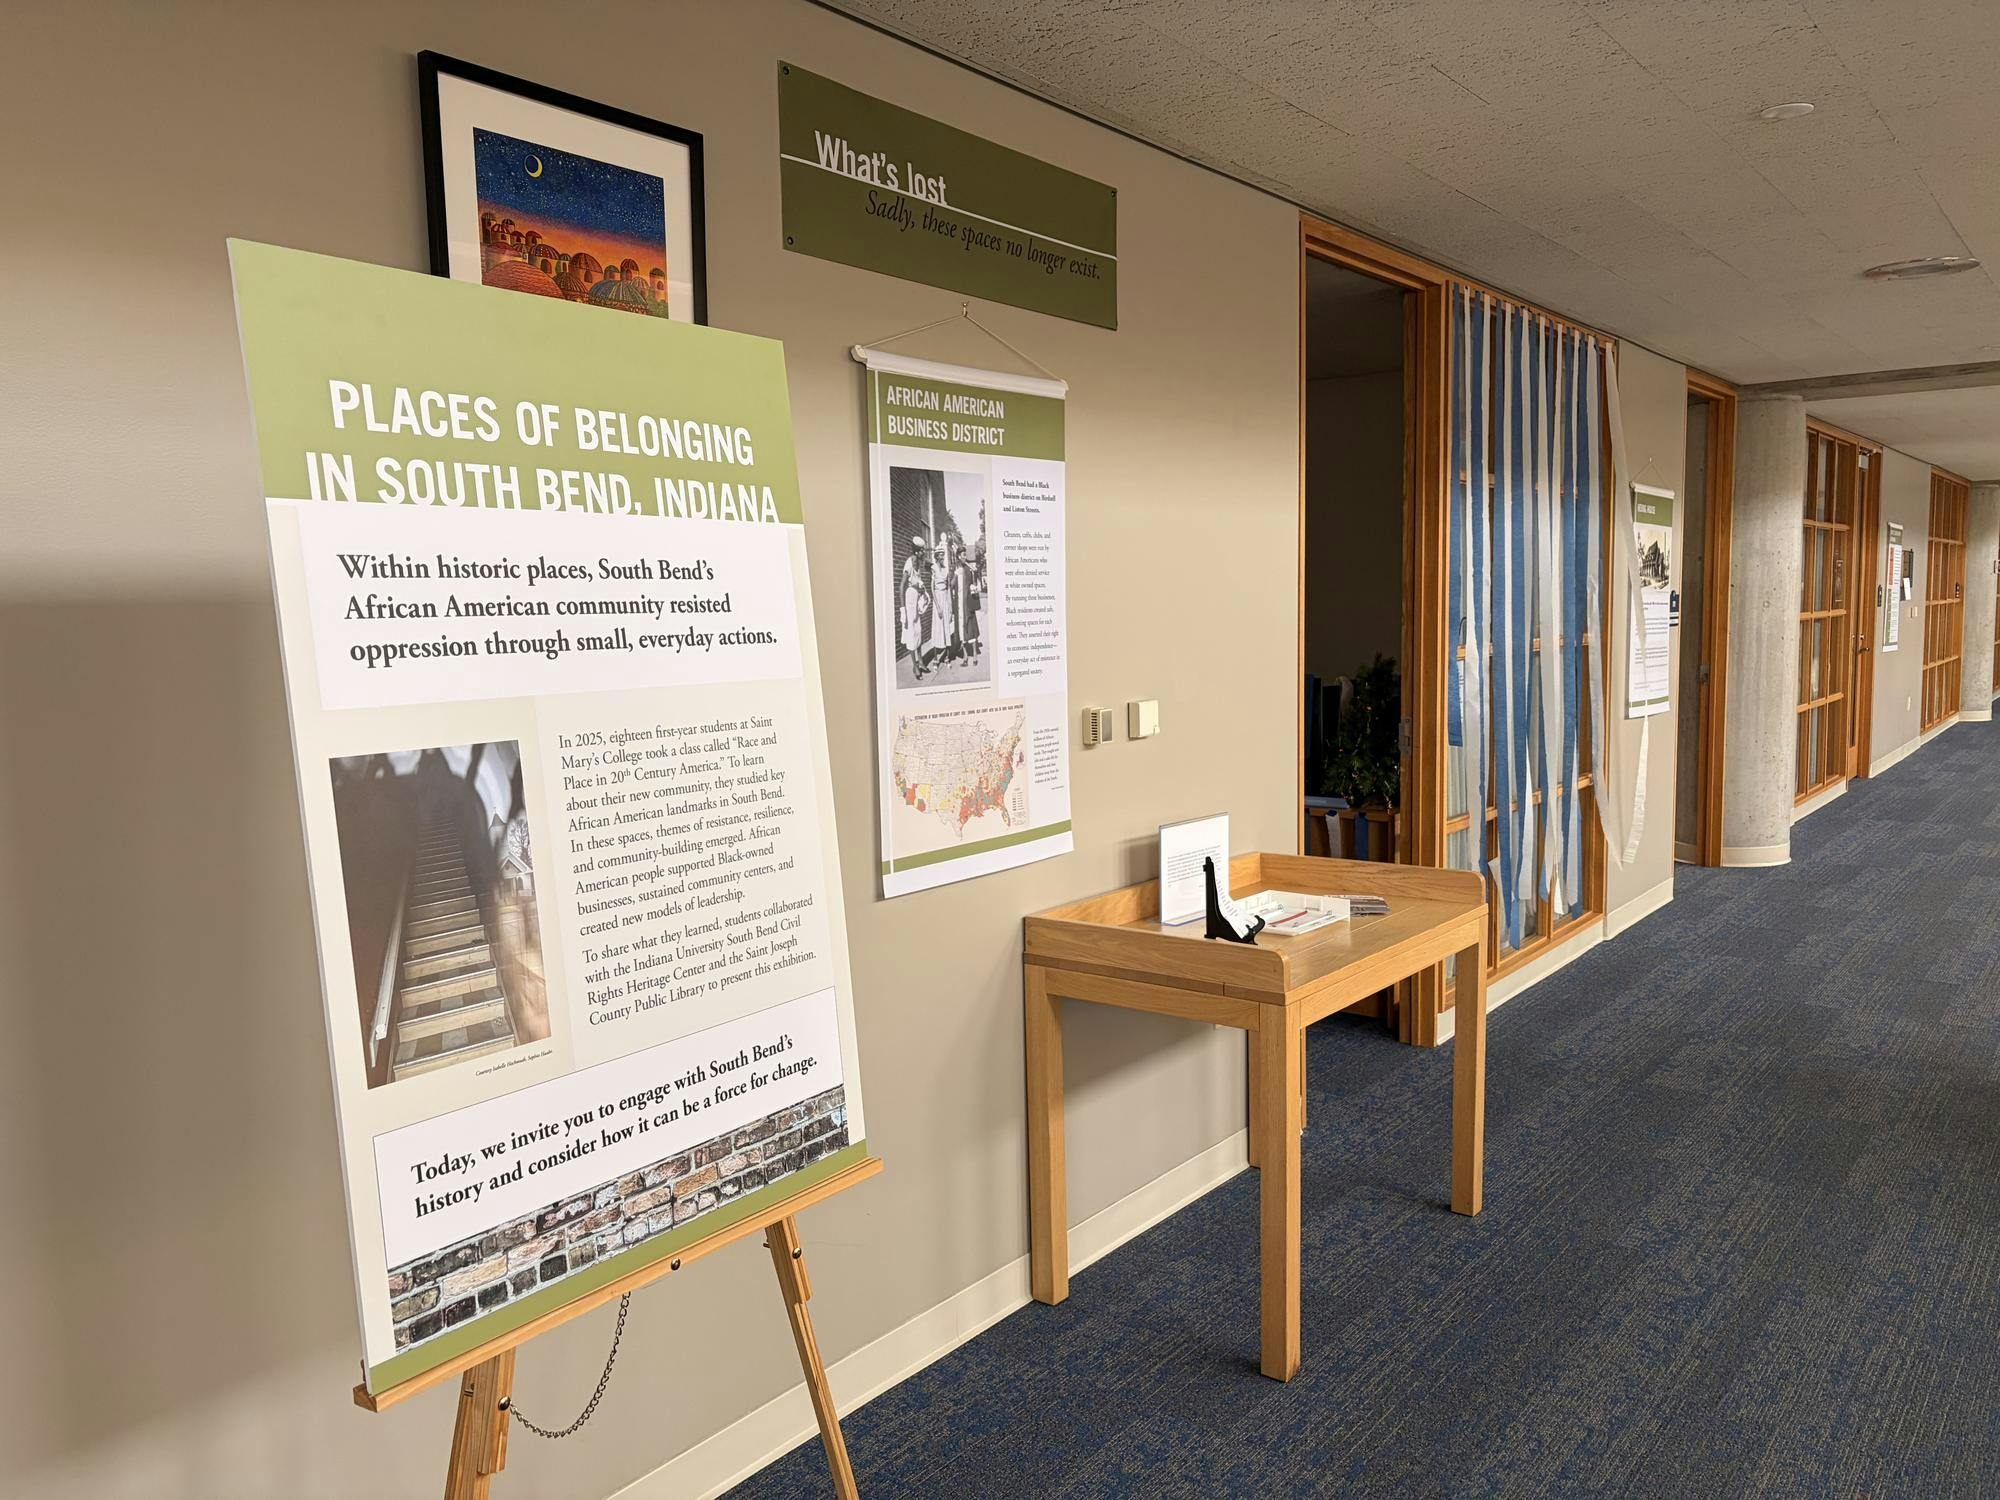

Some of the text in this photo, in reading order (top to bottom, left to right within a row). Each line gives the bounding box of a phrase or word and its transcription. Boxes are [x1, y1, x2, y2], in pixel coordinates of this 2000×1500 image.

[814, 130, 948, 205] What’s lost
[865, 190, 1101, 279] Sadly, these spaces no longer exist.
[329, 380, 753, 465] PLACES OF BELONGING
[886, 385, 1004, 418] AFRICAN AMERICAN
[888, 415, 1004, 445] BUSINESS DISTRICT
[304, 451, 780, 523] IN SOUTH BEND, INDIANA
[336, 553, 714, 586] Within historic places, South Bend’s
[344, 592, 732, 620] African American community resisted
[350, 625, 777, 668] oppression through small, everyday actions.
[558, 716, 772, 748] In 2025, eighteen first-year students at Saint
[561, 731, 777, 770] Mary’s College took a class called “Race and
[563, 753, 764, 790] Place in 20th Century America.” To learn
[566, 768, 785, 811] about their new community, they studied key
[568, 785, 784, 832] African American landmarks in South Bend.
[570, 805, 794, 853] In these spaces, themes of resistance, resilience,
[573, 825, 780, 873] and community-building emerged. African
[575, 841, 774, 895] American people supported Black-owned
[577, 855, 794, 915] businesses, sustained community centers, and
[579, 888, 745, 936] created new models of leadership.
[581, 893, 812, 963] To share what they learned, students collaborated
[584, 914, 800, 983] with the Indiana University South Bend Civil
[587, 934, 797, 1006] Rights Heritage Center and the Saint Joseph
[589, 951, 816, 1025] County Public Library to present this exhibition.
[410, 1034, 792, 1184] Today, we invite you to engage with South Bend’s
[414, 1056, 817, 1218] history and consider how it can be a force for change.
